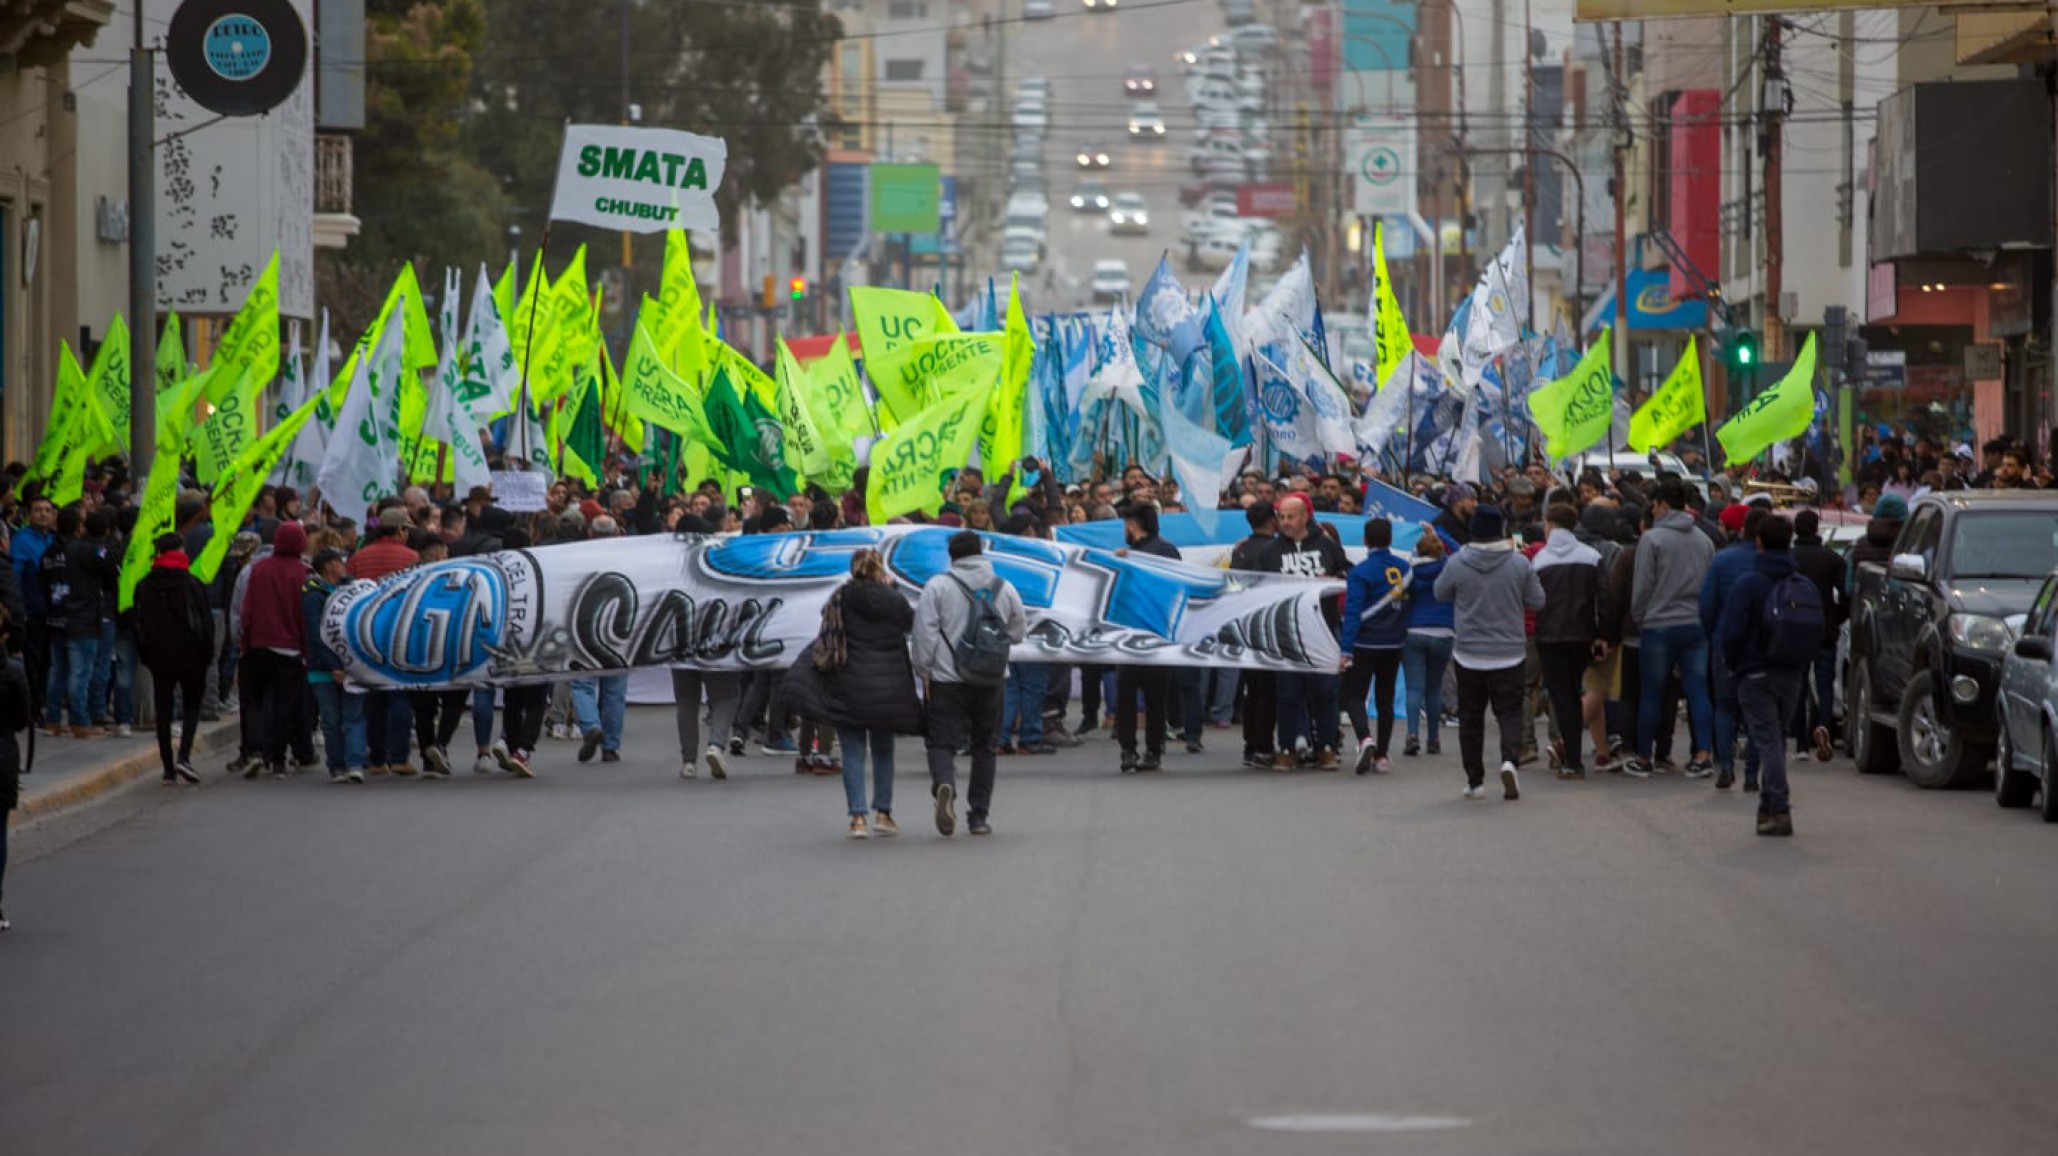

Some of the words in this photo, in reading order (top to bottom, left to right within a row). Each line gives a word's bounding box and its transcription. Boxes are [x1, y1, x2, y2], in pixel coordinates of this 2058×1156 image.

[577, 144, 708, 190] SMATA
[595, 196, 679, 222] CHUBUT
[1281, 550, 1325, 573] JUST
[571, 571, 785, 671] SAUL
